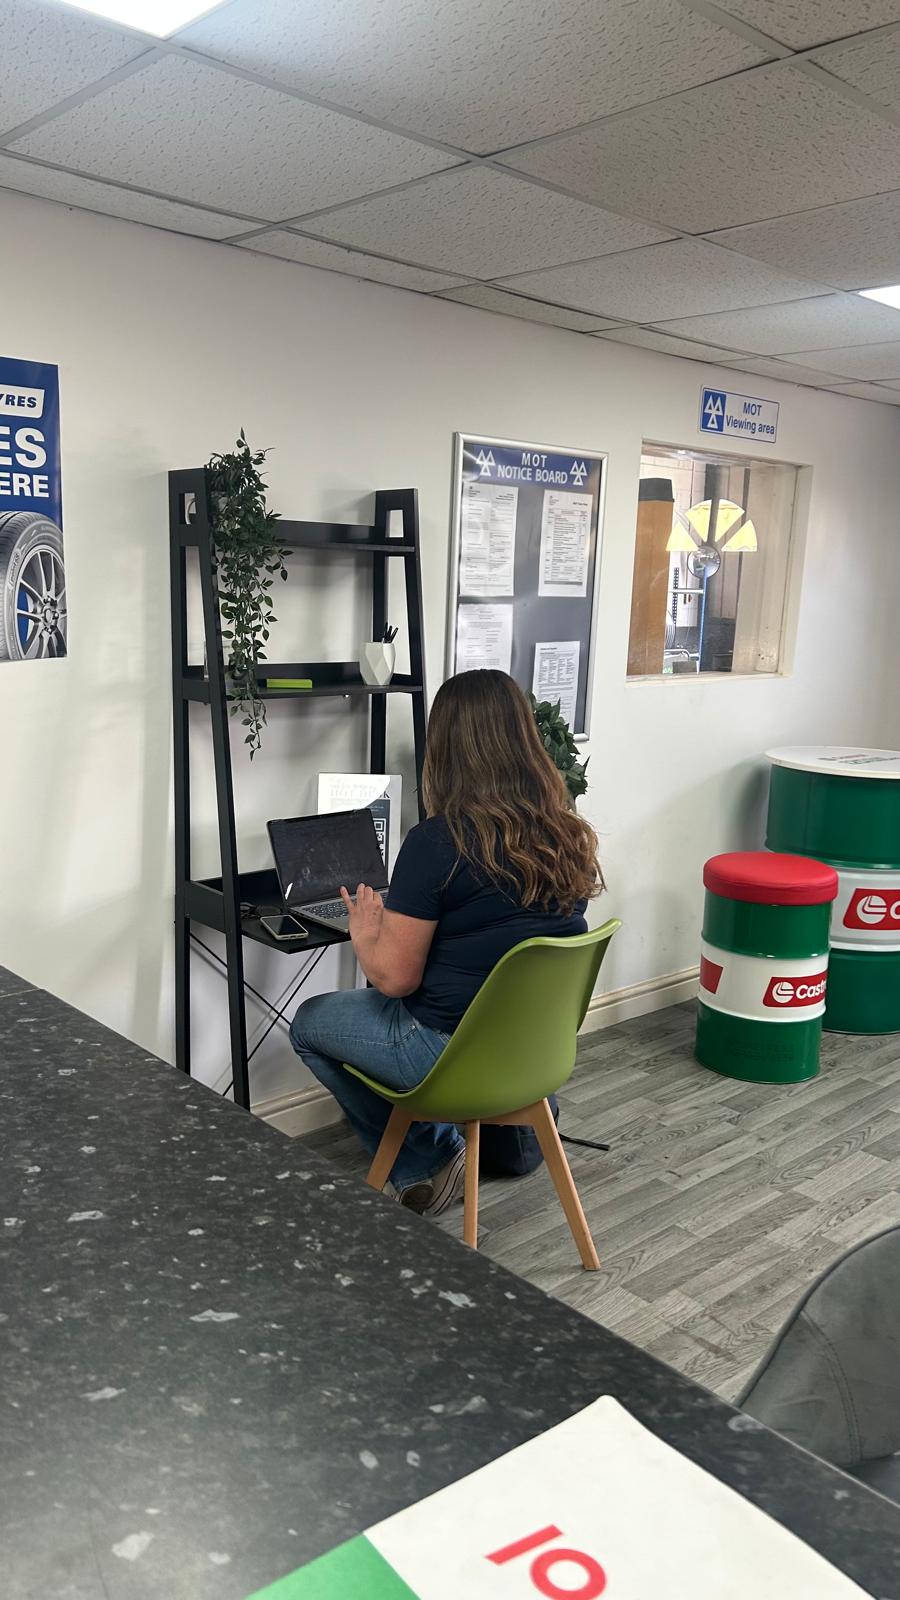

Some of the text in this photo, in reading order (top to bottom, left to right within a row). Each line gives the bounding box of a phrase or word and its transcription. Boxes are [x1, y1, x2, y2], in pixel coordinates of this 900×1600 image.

[743, 402, 762, 416] MOT
[726, 415, 775, 434] Viewing area
[521, 453, 547, 468] MOT
[497, 465, 568, 484] NOTICE BOARD
